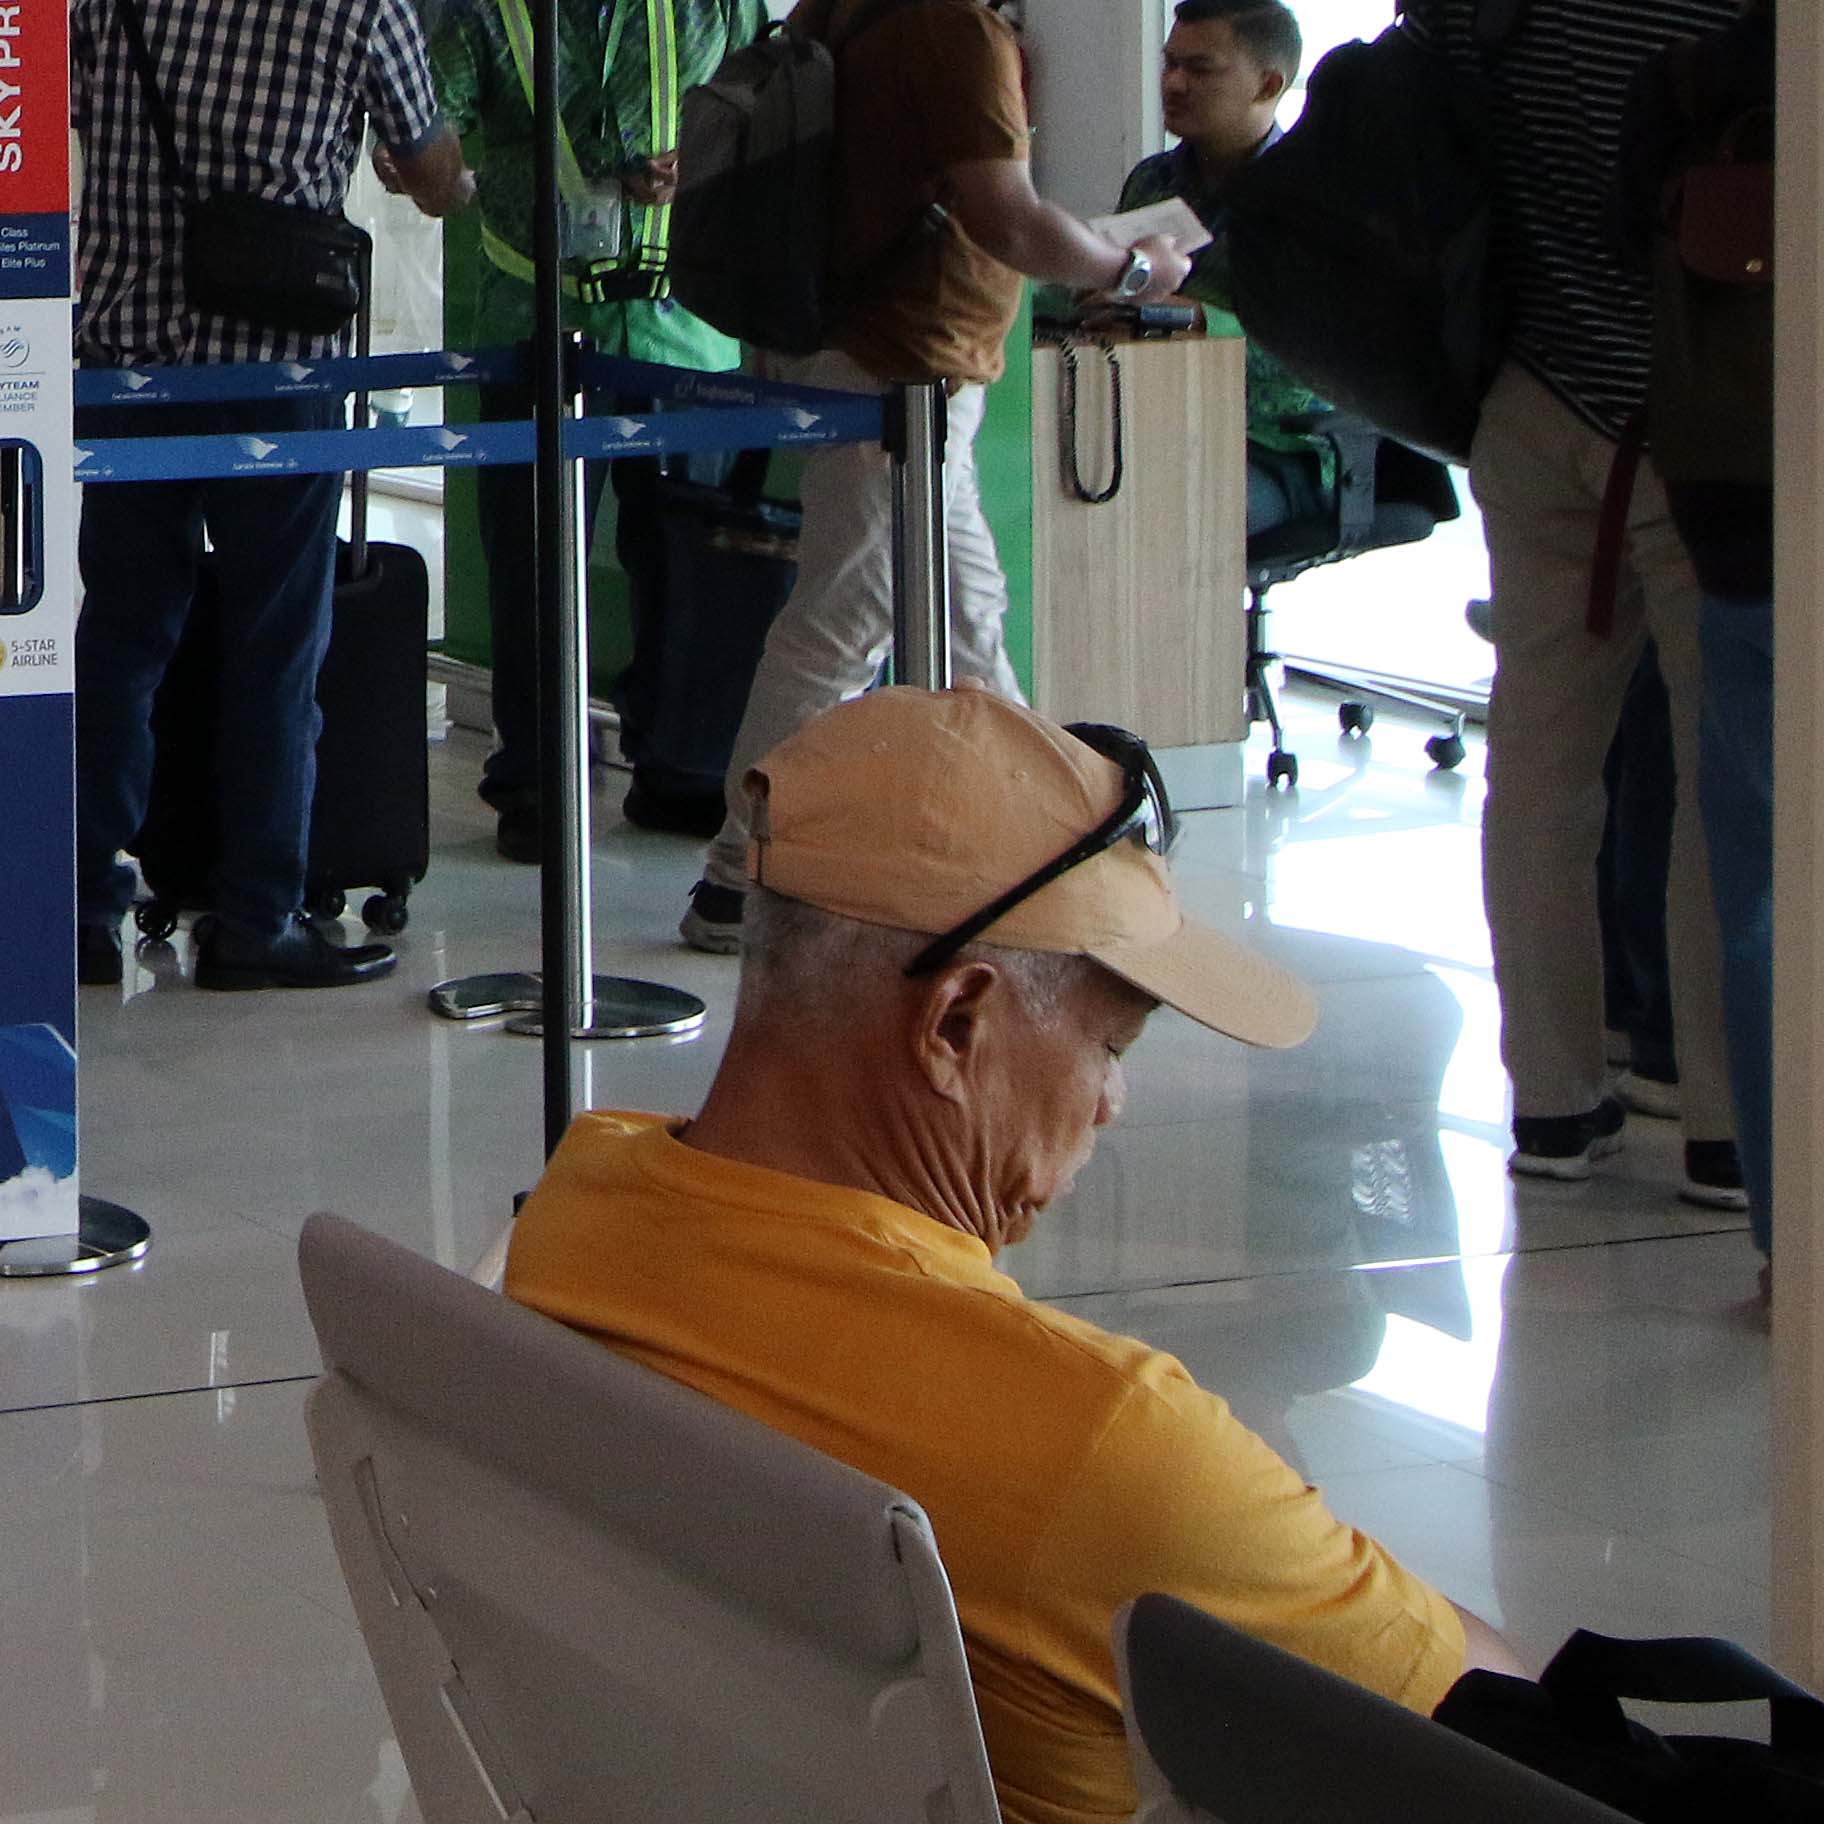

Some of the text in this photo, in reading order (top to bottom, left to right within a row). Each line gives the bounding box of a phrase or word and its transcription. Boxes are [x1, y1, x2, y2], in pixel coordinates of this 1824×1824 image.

[1, 226, 29, 239] Class
[1, 257, 23, 269] Elite
[24, 257, 47, 269] Plus
[11, 639, 56, 652] 5-STAR
[11, 653, 58, 667] AIRLINE
